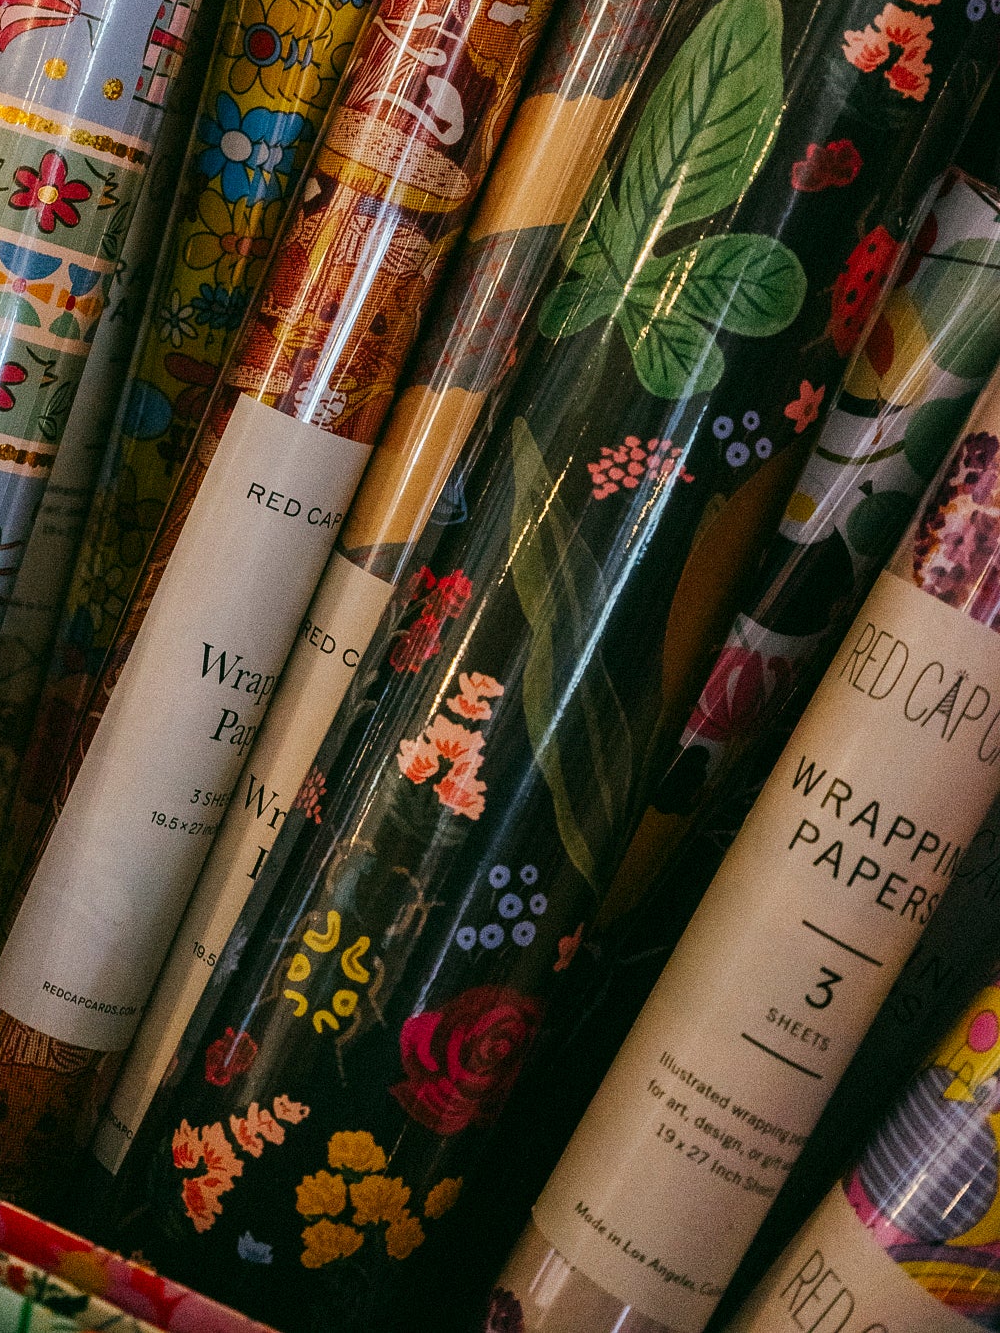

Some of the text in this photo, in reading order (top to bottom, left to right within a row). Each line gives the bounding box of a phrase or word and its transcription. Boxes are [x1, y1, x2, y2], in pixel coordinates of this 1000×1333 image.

[246, 482, 342, 529] RED CAP
[838, 622, 909, 700] RED
[904, 661, 991, 743] CAP
[190, 788, 201, 804] 3
[151, 811, 178, 830] 19.5
[188, 822, 203, 835] 27
[788, 819, 940, 925] PAPERS
[192, 941, 217, 967] 19.5
[42, 980, 137, 1016] REDCAPCARDS.COM
[805, 966, 843, 1010] 3
[766, 1007, 830, 1052] SHEETS
[659, 1051, 731, 1109] Illustrated
[647, 1078, 666, 1099] for
[666, 1097, 689, 1122] art,
[694, 1117, 744, 1156] design,
[656, 1123, 676, 1144] 19
[686, 1145, 710, 1165] 27
[575, 1201, 607, 1234] Made
[607, 1232, 622, 1246] in
[623, 1240, 646, 1263] Los
[779, 1249, 855, 1333] RED
